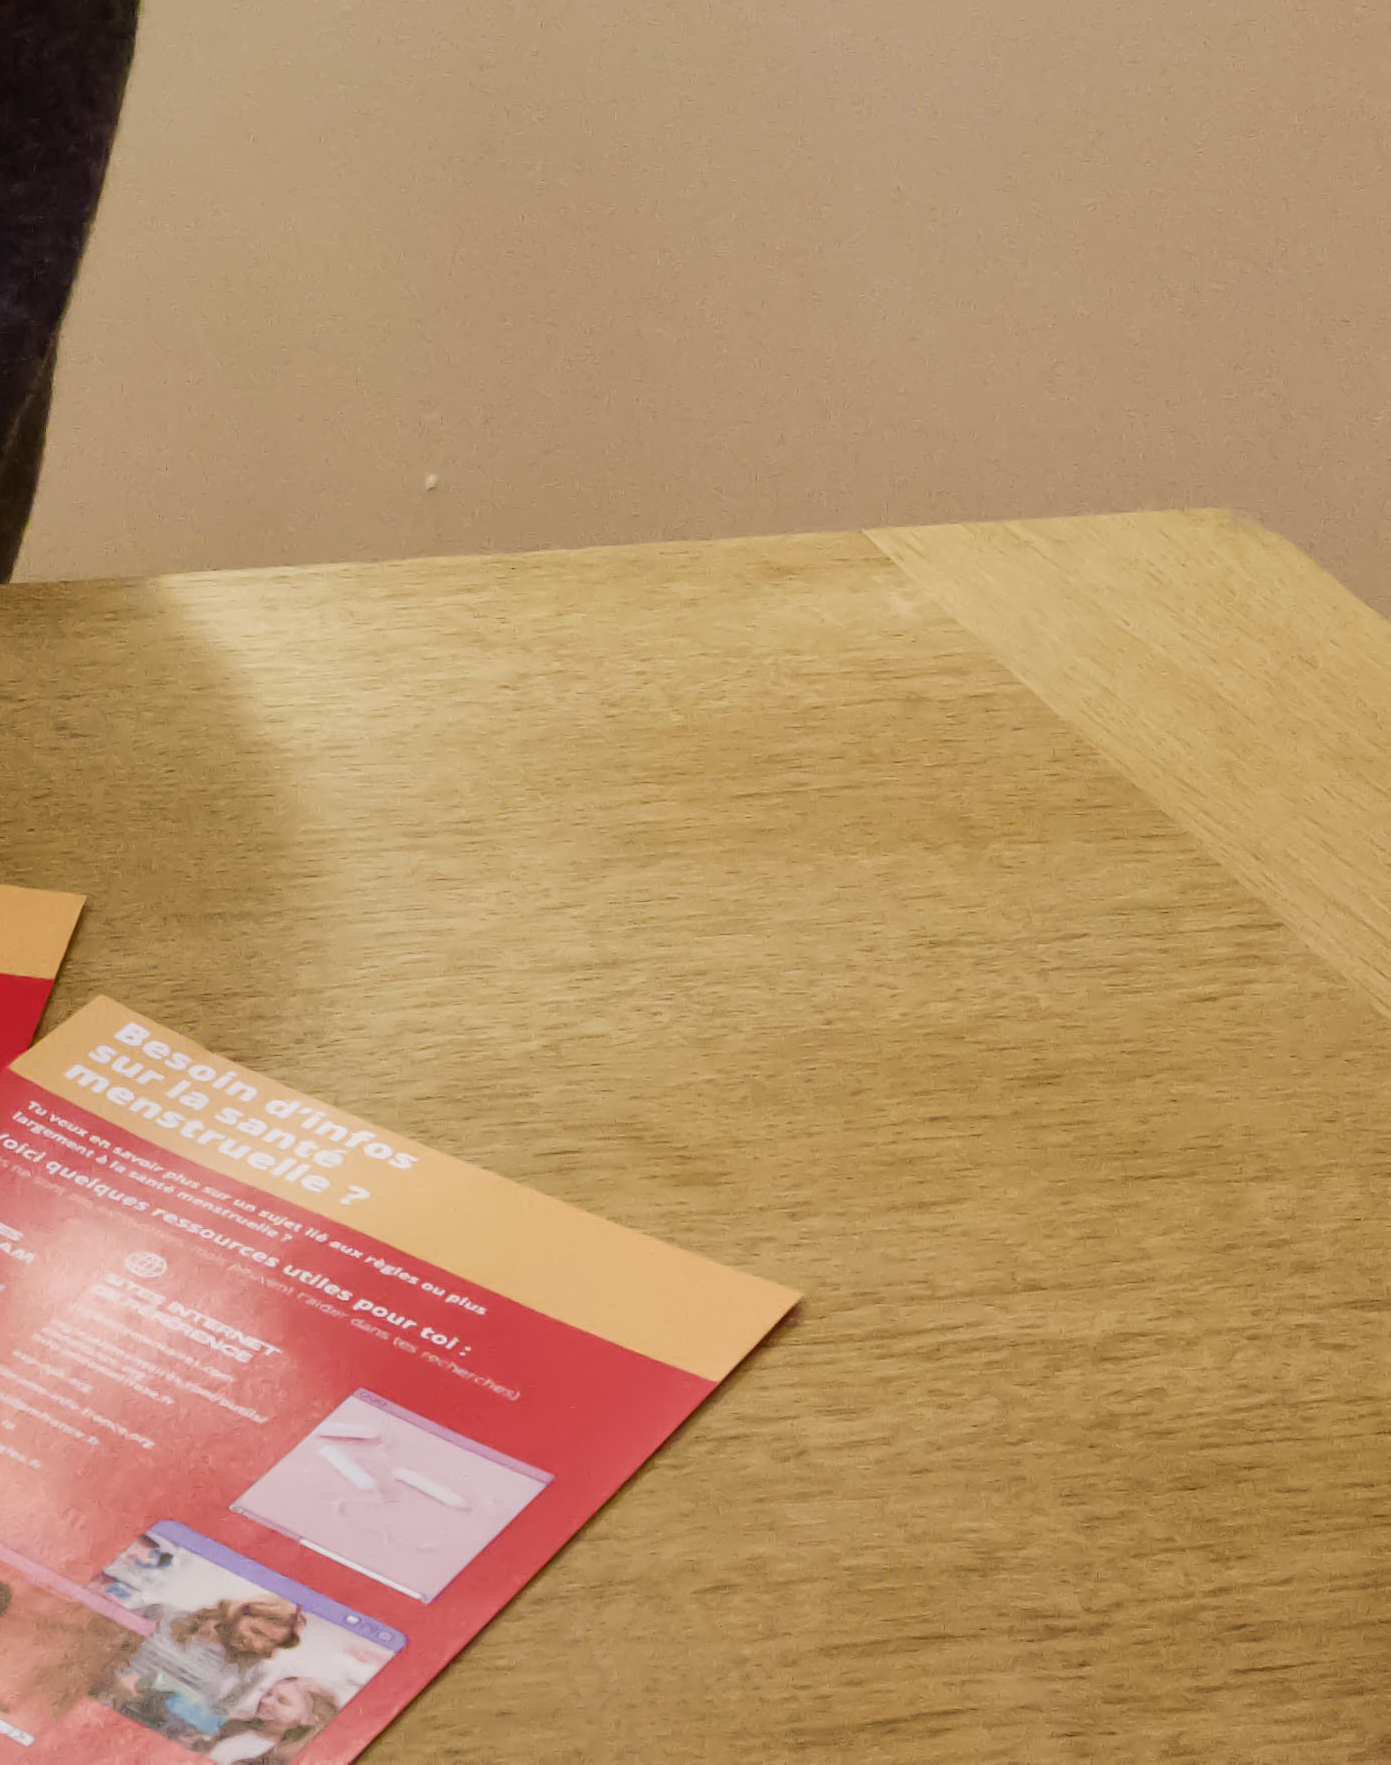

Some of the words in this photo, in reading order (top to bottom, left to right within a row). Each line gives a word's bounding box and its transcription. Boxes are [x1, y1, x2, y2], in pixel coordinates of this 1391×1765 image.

[88, 1044, 165, 1085] sur
[165, 1078, 209, 1111] la
[214, 1107, 346, 1169] santé
[114, 1021, 258, 1102] Besoin
[64, 1063, 330, 1193] menstruelle
[339, 1184, 370, 1205] ?
[45, 1160, 149, 1211] quelques
[151, 1207, 279, 1267] ressources
[282, 1263, 353, 1301] utiles
[352, 1298, 417, 1329] pour
[419, 1326, 458, 1349] toi
